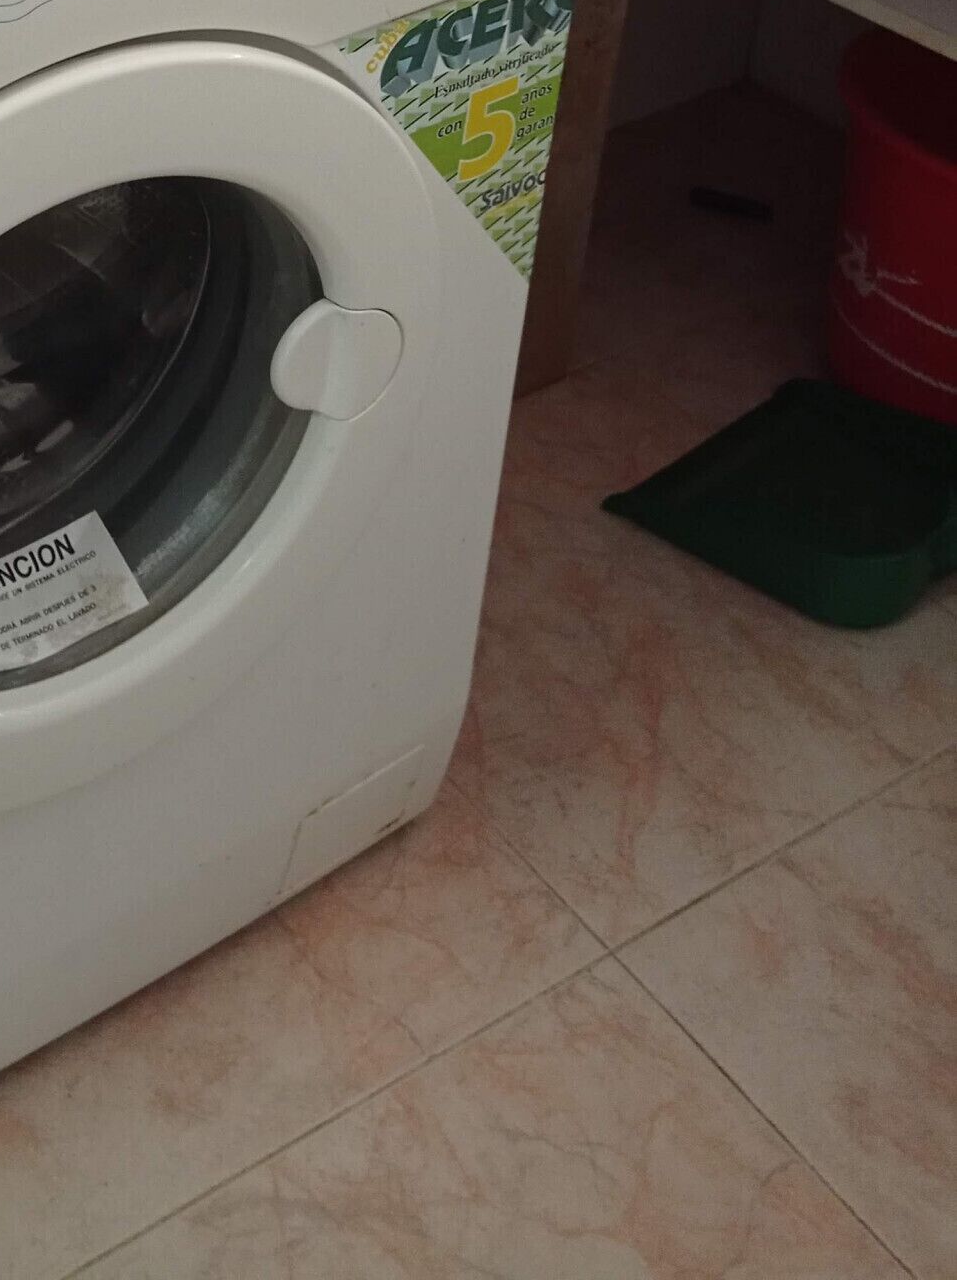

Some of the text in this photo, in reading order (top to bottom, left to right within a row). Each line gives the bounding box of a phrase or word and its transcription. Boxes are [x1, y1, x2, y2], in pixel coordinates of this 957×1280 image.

[433, 43, 555, 99] Esmaltado vitrificado
[437, 74, 553, 182] con 5 años
[516, 114, 554, 140] garan
[519, 106, 535, 122] de
[12, 586, 23, 597] UN
[25, 573, 54, 591] SISTEMA
[0, 641, 11, 651] DE
[12, 622, 54, 646] TERMINADO
[56, 618, 67, 627] EL
[68, 601, 97, 621] LAVADO
[20, 611, 41, 626] ABRIR
[78, 588, 89, 600] DE
